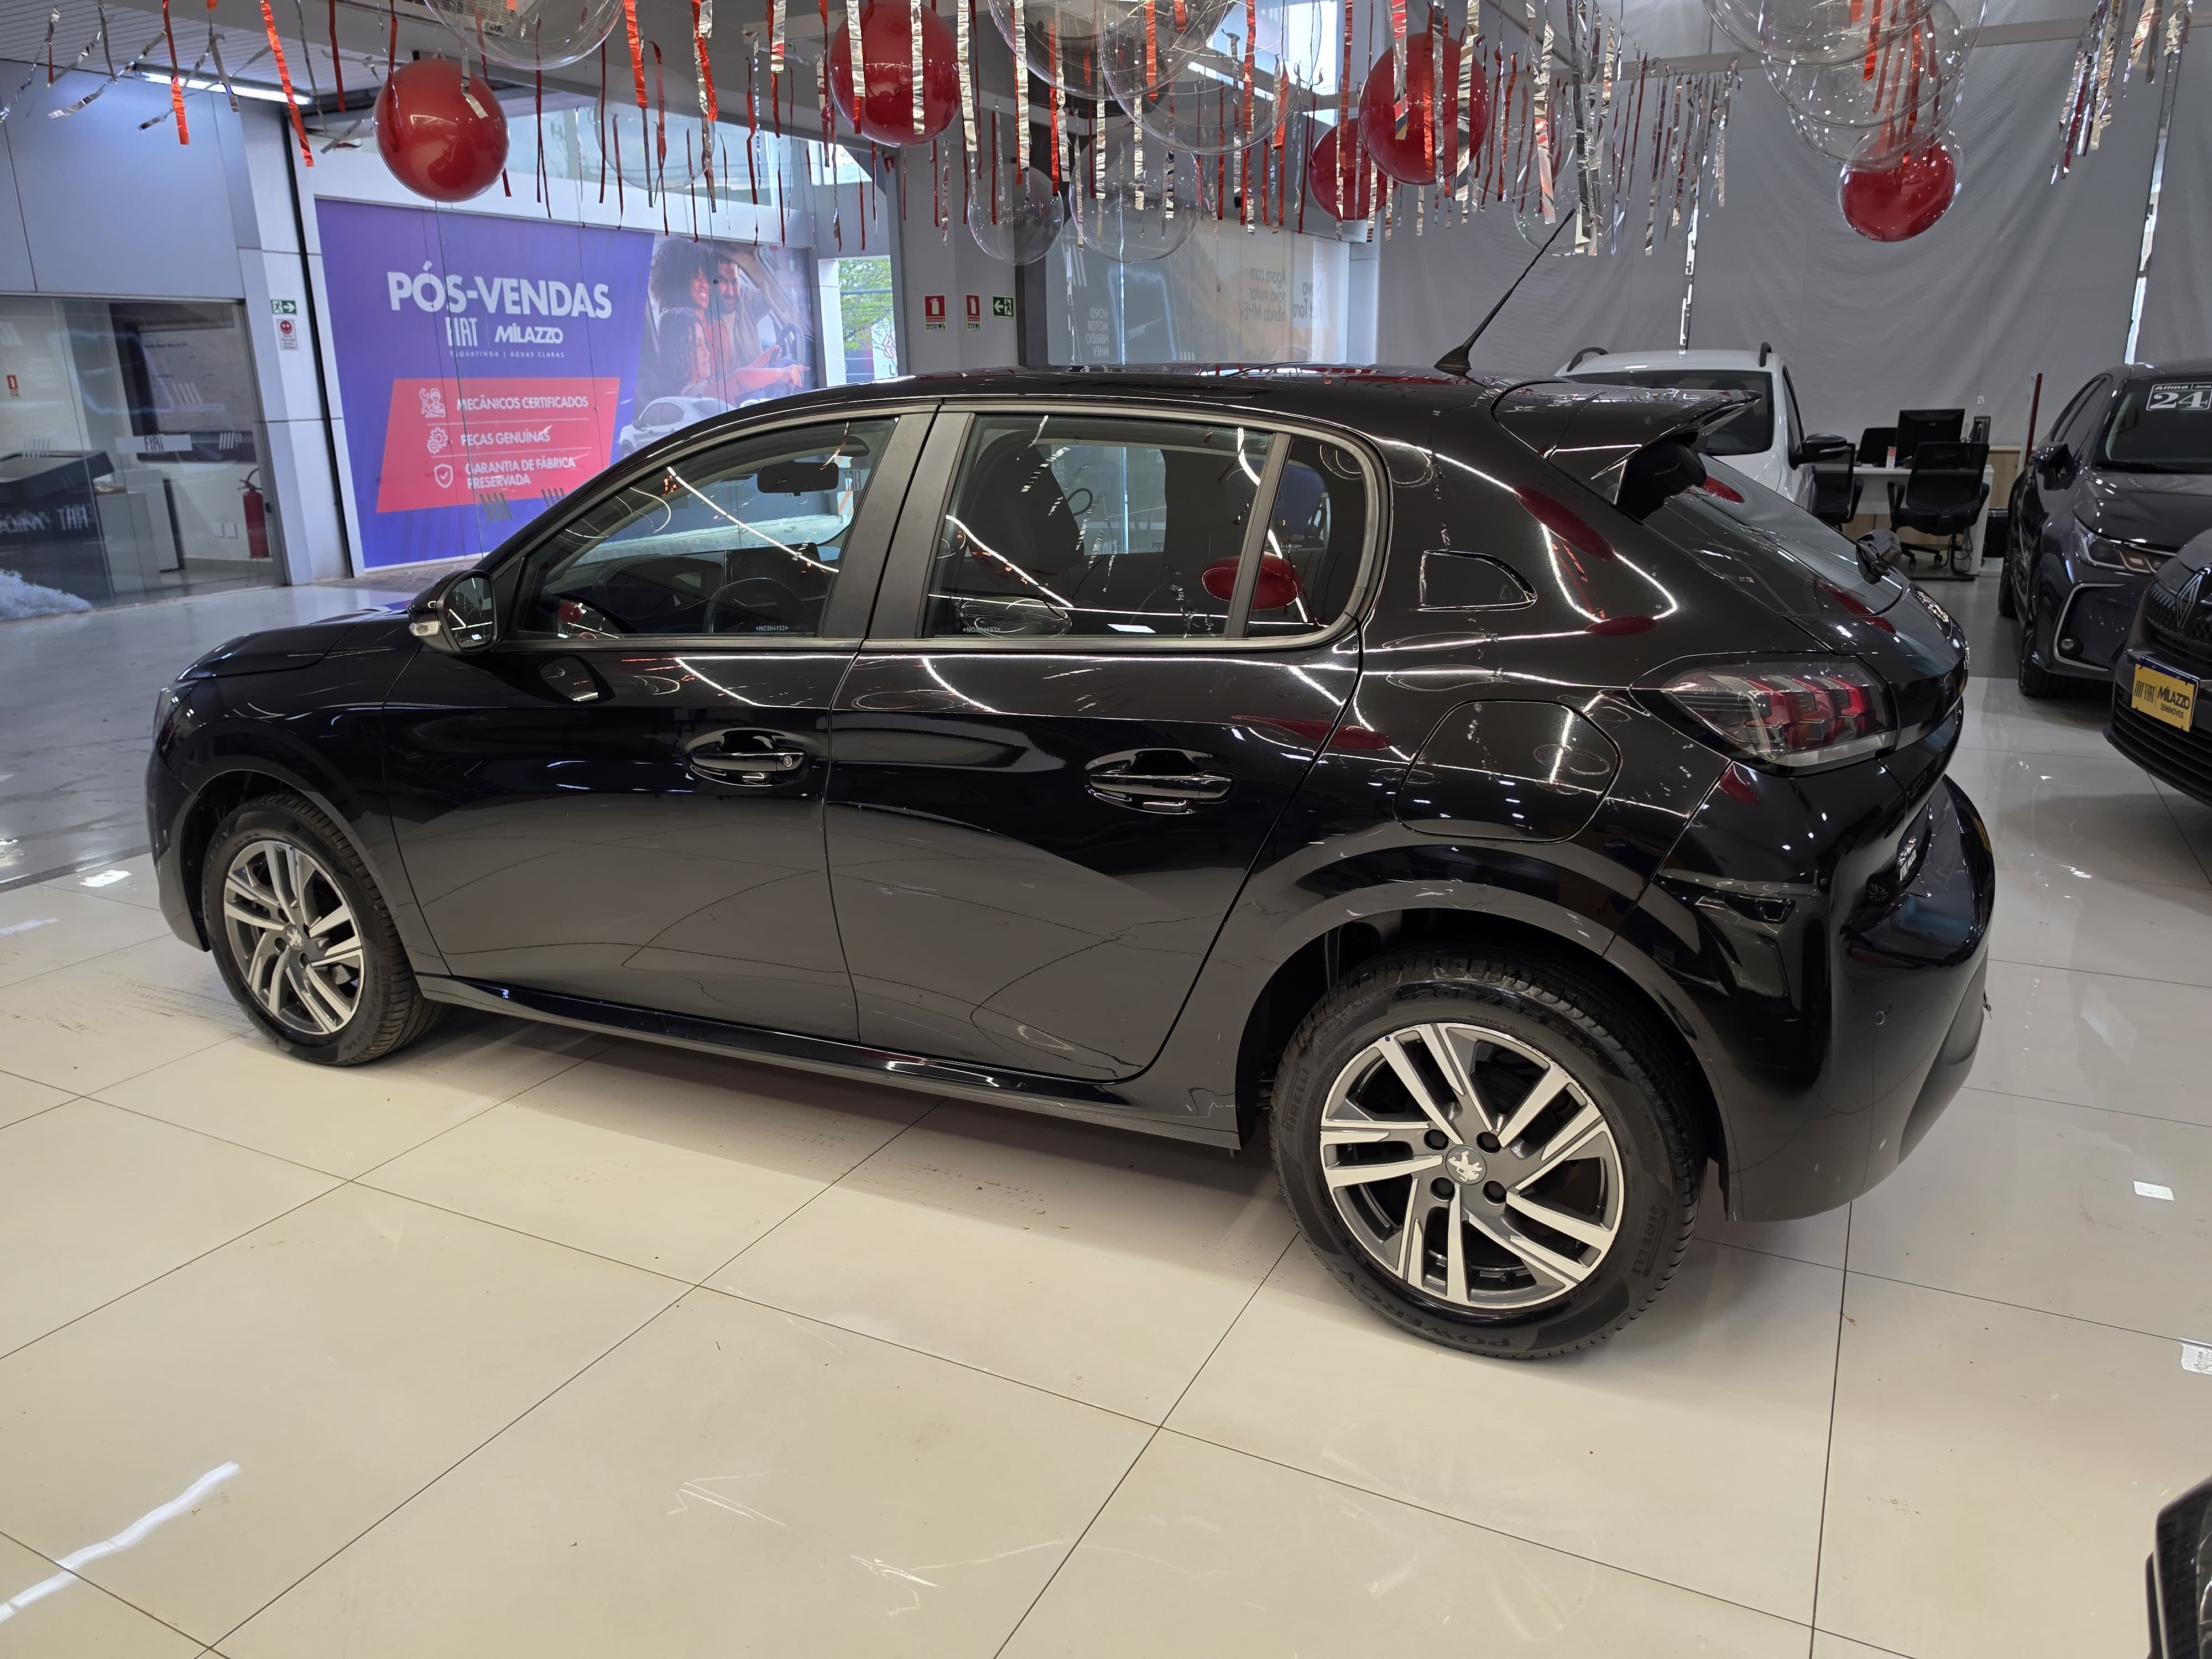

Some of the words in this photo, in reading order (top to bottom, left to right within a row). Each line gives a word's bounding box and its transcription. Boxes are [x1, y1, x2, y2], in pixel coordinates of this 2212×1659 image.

[387, 260, 612, 319] PÓS-VENDAS
[445, 317, 478, 347] FIAT
[457, 394, 521, 410] MECÂNICOS
[521, 396, 588, 409] CERTIFICADOS
[2149, 392, 2208, 409] 24
[461, 433, 494, 449] PEÇAS
[495, 428, 550, 445] GENUÍNAS
[465, 460, 520, 475] GARANTIA
[521, 460, 534, 471] DE
[536, 455, 576, 469] FÁBRICA
[467, 473, 531, 489] PRESERVADA
[2144, 684, 2155, 703] FIAT
[2161, 703, 2184, 719] SEMINOVOS
[1281, 1063, 1310, 1133] PIRELLI
[1631, 1204, 1669, 1277] PIRELLI
